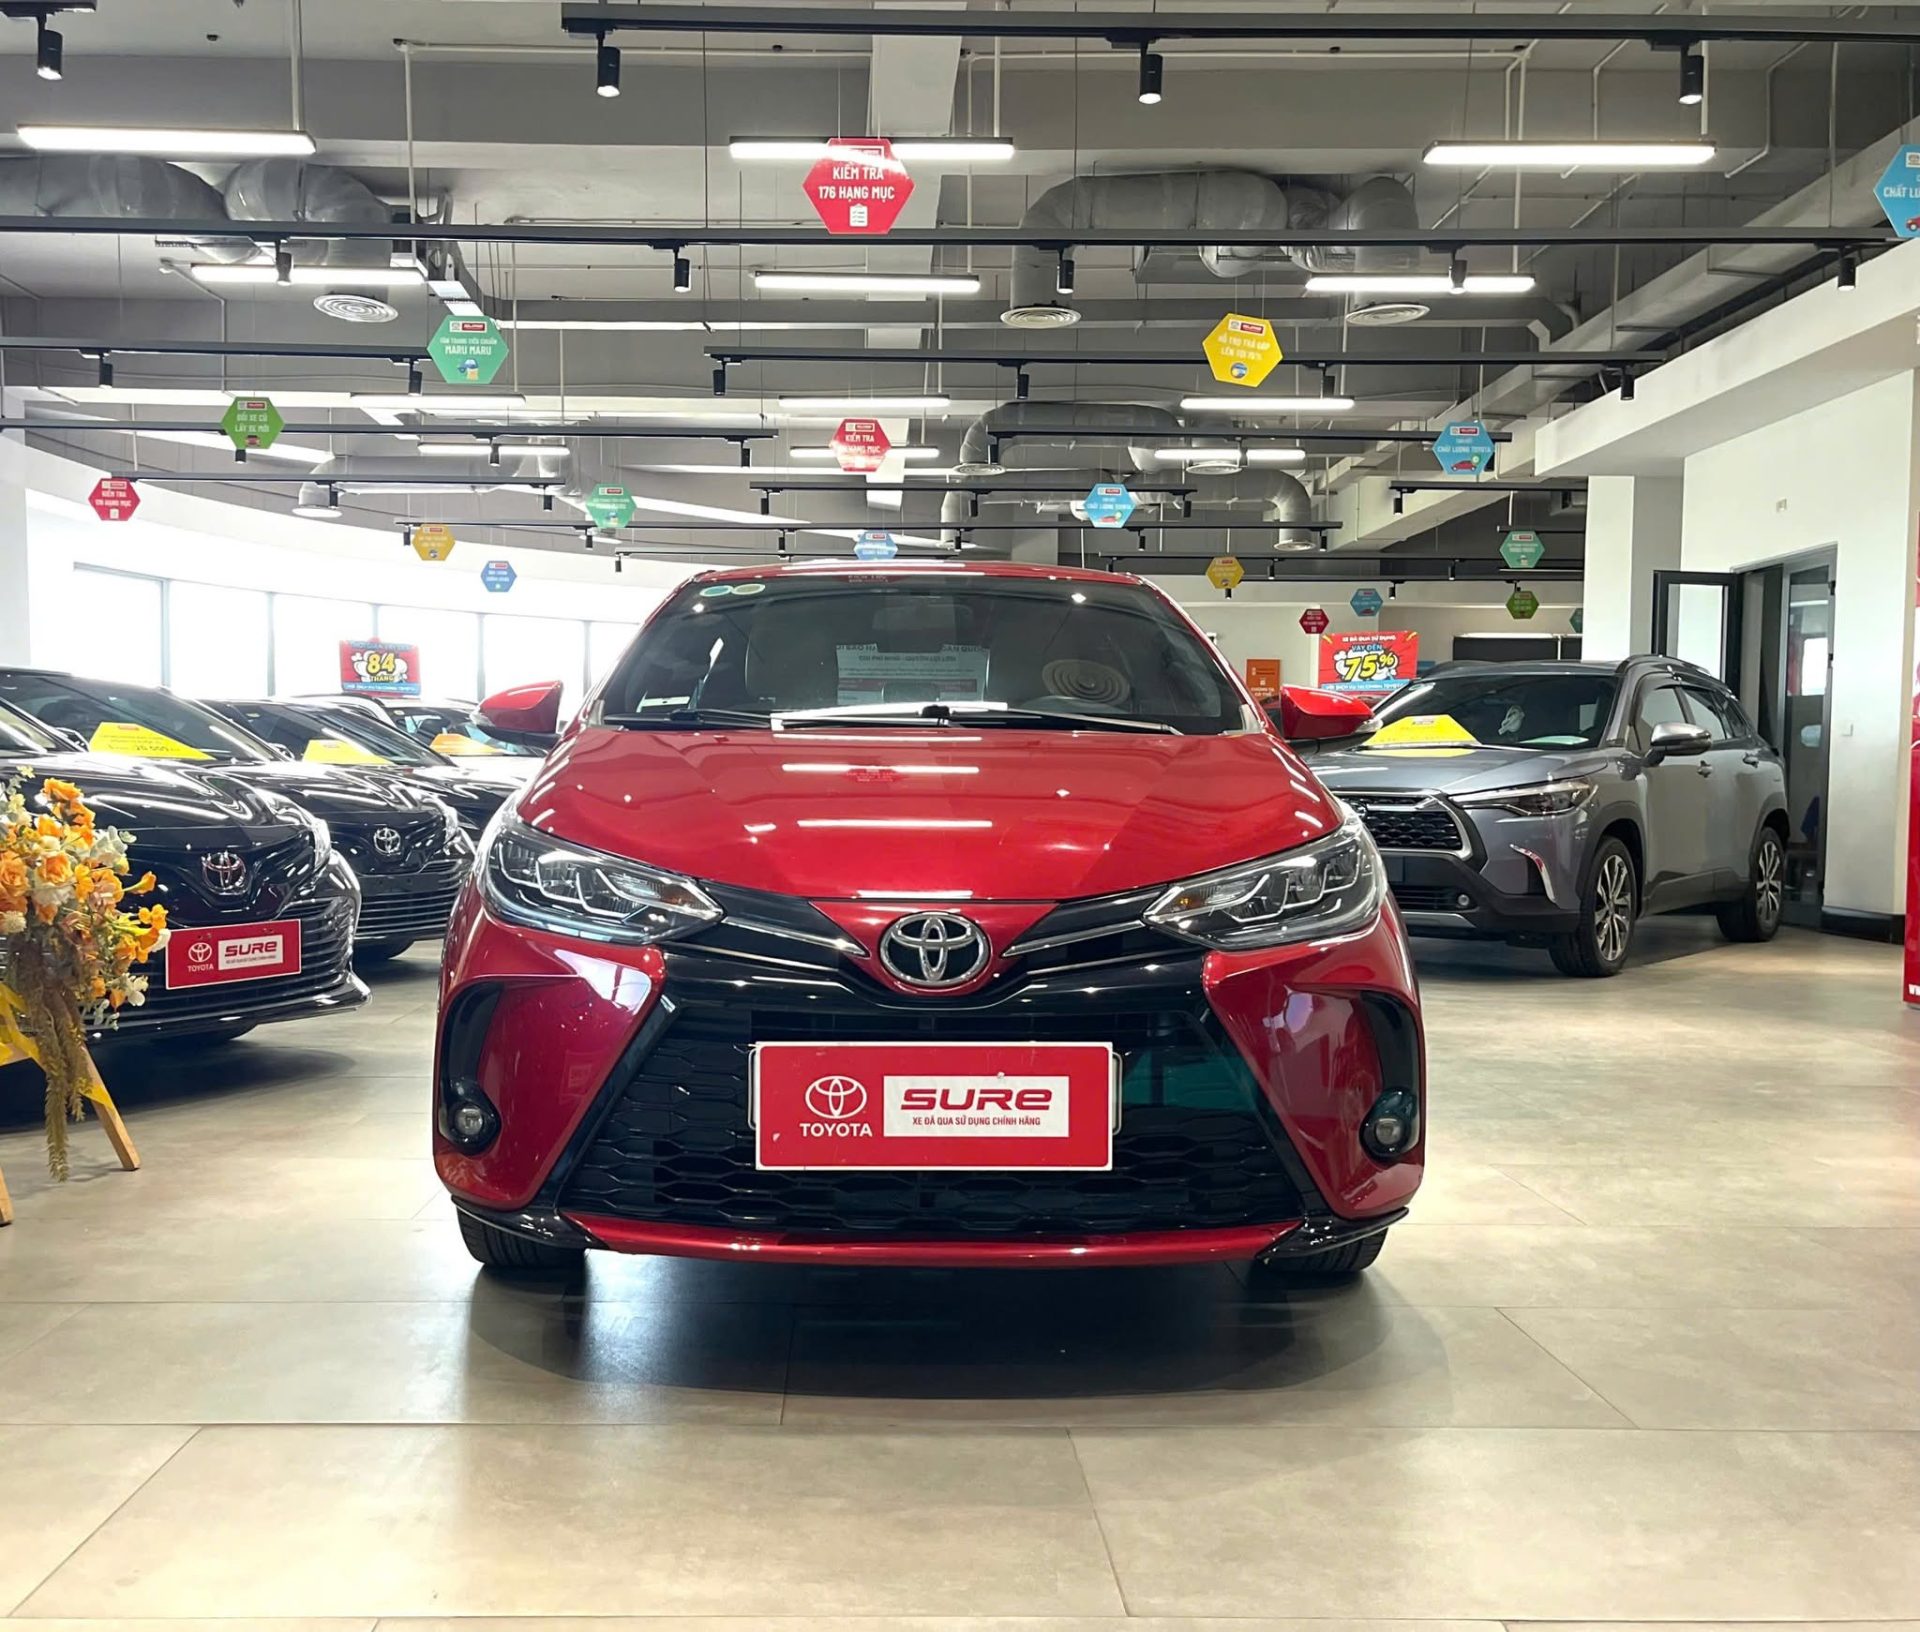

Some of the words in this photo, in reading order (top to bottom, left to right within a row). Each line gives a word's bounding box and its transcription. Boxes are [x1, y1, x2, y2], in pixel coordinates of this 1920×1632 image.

[862, 167, 884, 180] TRA
[818, 186, 836, 199] 176
[838, 186, 869, 202] HẠNG
[871, 186, 895, 203] MỤC
[1883, 184, 1906, 198] CHẤT
[445, 346, 467, 355] MARU
[469, 346, 492, 355] MARU
[367, 652, 396, 676] 84
[1343, 652, 1395, 681] 75%
[187, 963, 214, 972] TOYOTA
[912, 1116, 922, 1125] XE
[924, 1115, 935, 1125] ĐÃ
[937, 1116, 953, 1125] QUA
[955, 1115, 967, 1125] SỬ
[968, 1116, 990, 1127] DỤNG
[992, 1115, 1017, 1125] CHÍNH
[1018, 1115, 1041, 1125] HÃNG
[800, 1122, 873, 1137] TOYOTA
